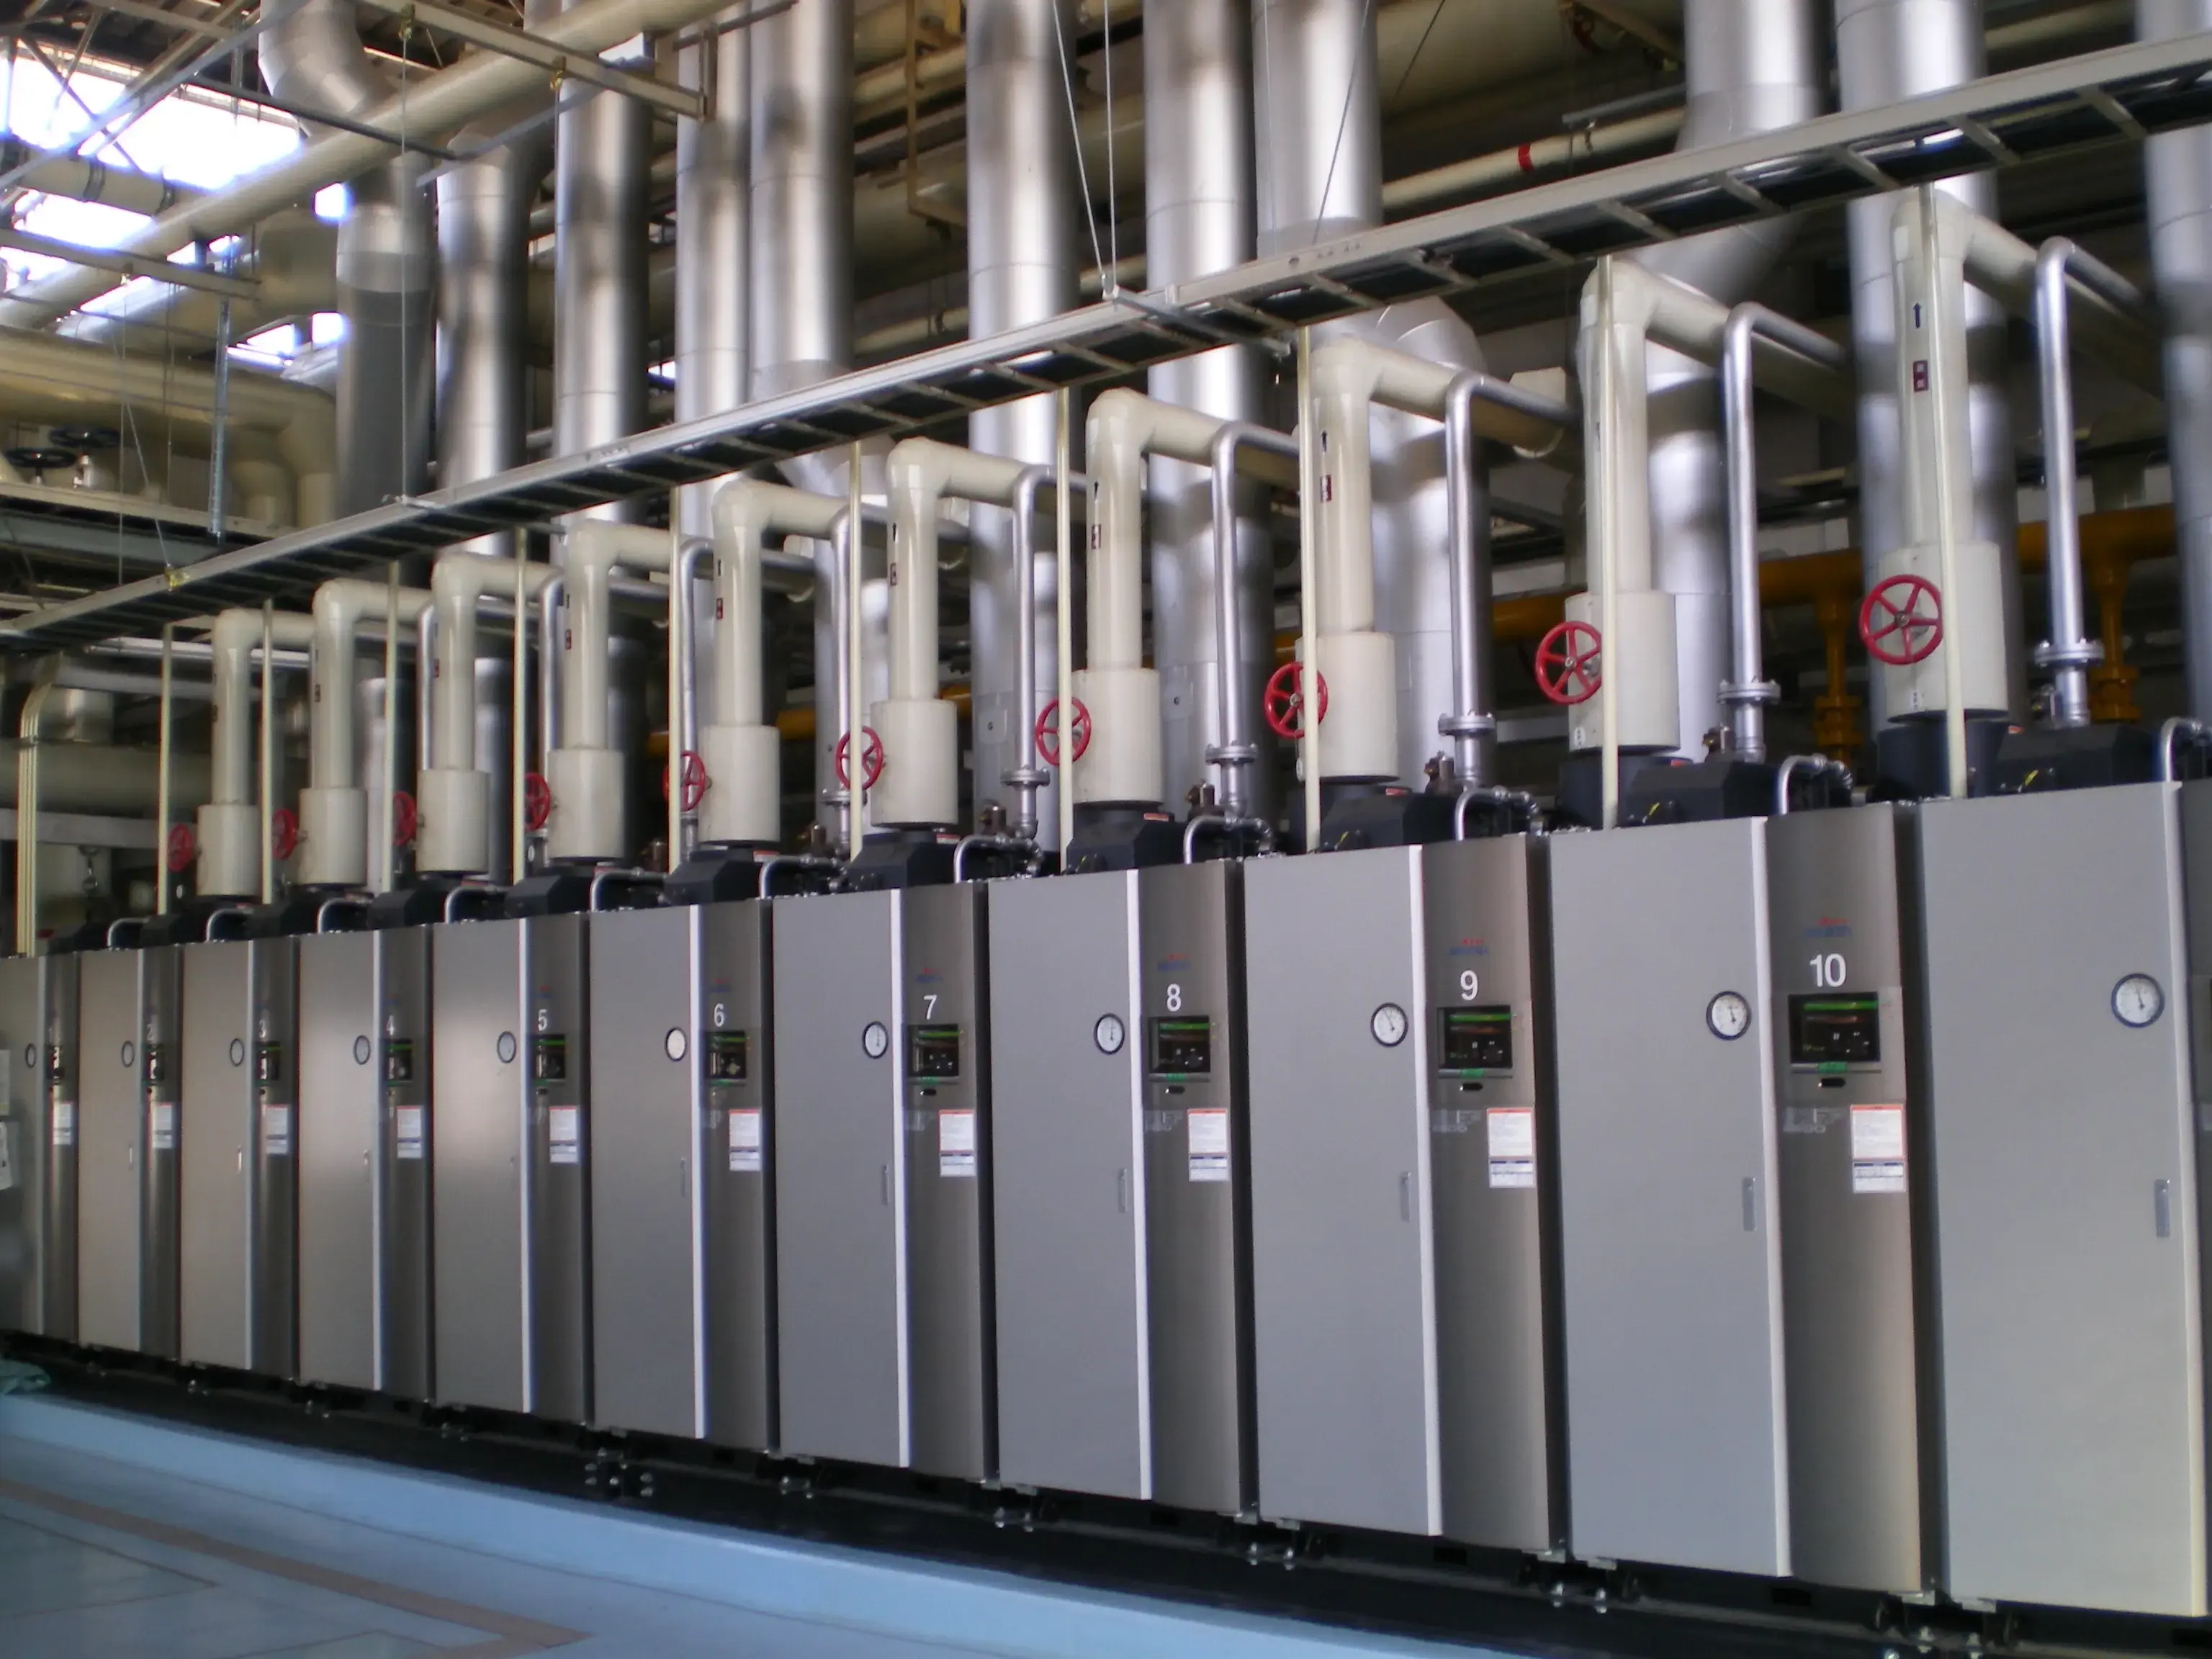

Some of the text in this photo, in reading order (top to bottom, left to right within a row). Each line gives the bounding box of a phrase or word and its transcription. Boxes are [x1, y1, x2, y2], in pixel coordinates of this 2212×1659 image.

[1809, 953, 1846, 987] 10
[1460, 970, 1478, 1000] 9
[923, 994, 938, 1020] 7
[1166, 984, 1182, 1012] 8
[386, 1015, 395, 1035] 4
[538, 1009, 547, 1031] 5
[714, 1003, 725, 1027] 6
[147, 1023, 154, 1040] 2
